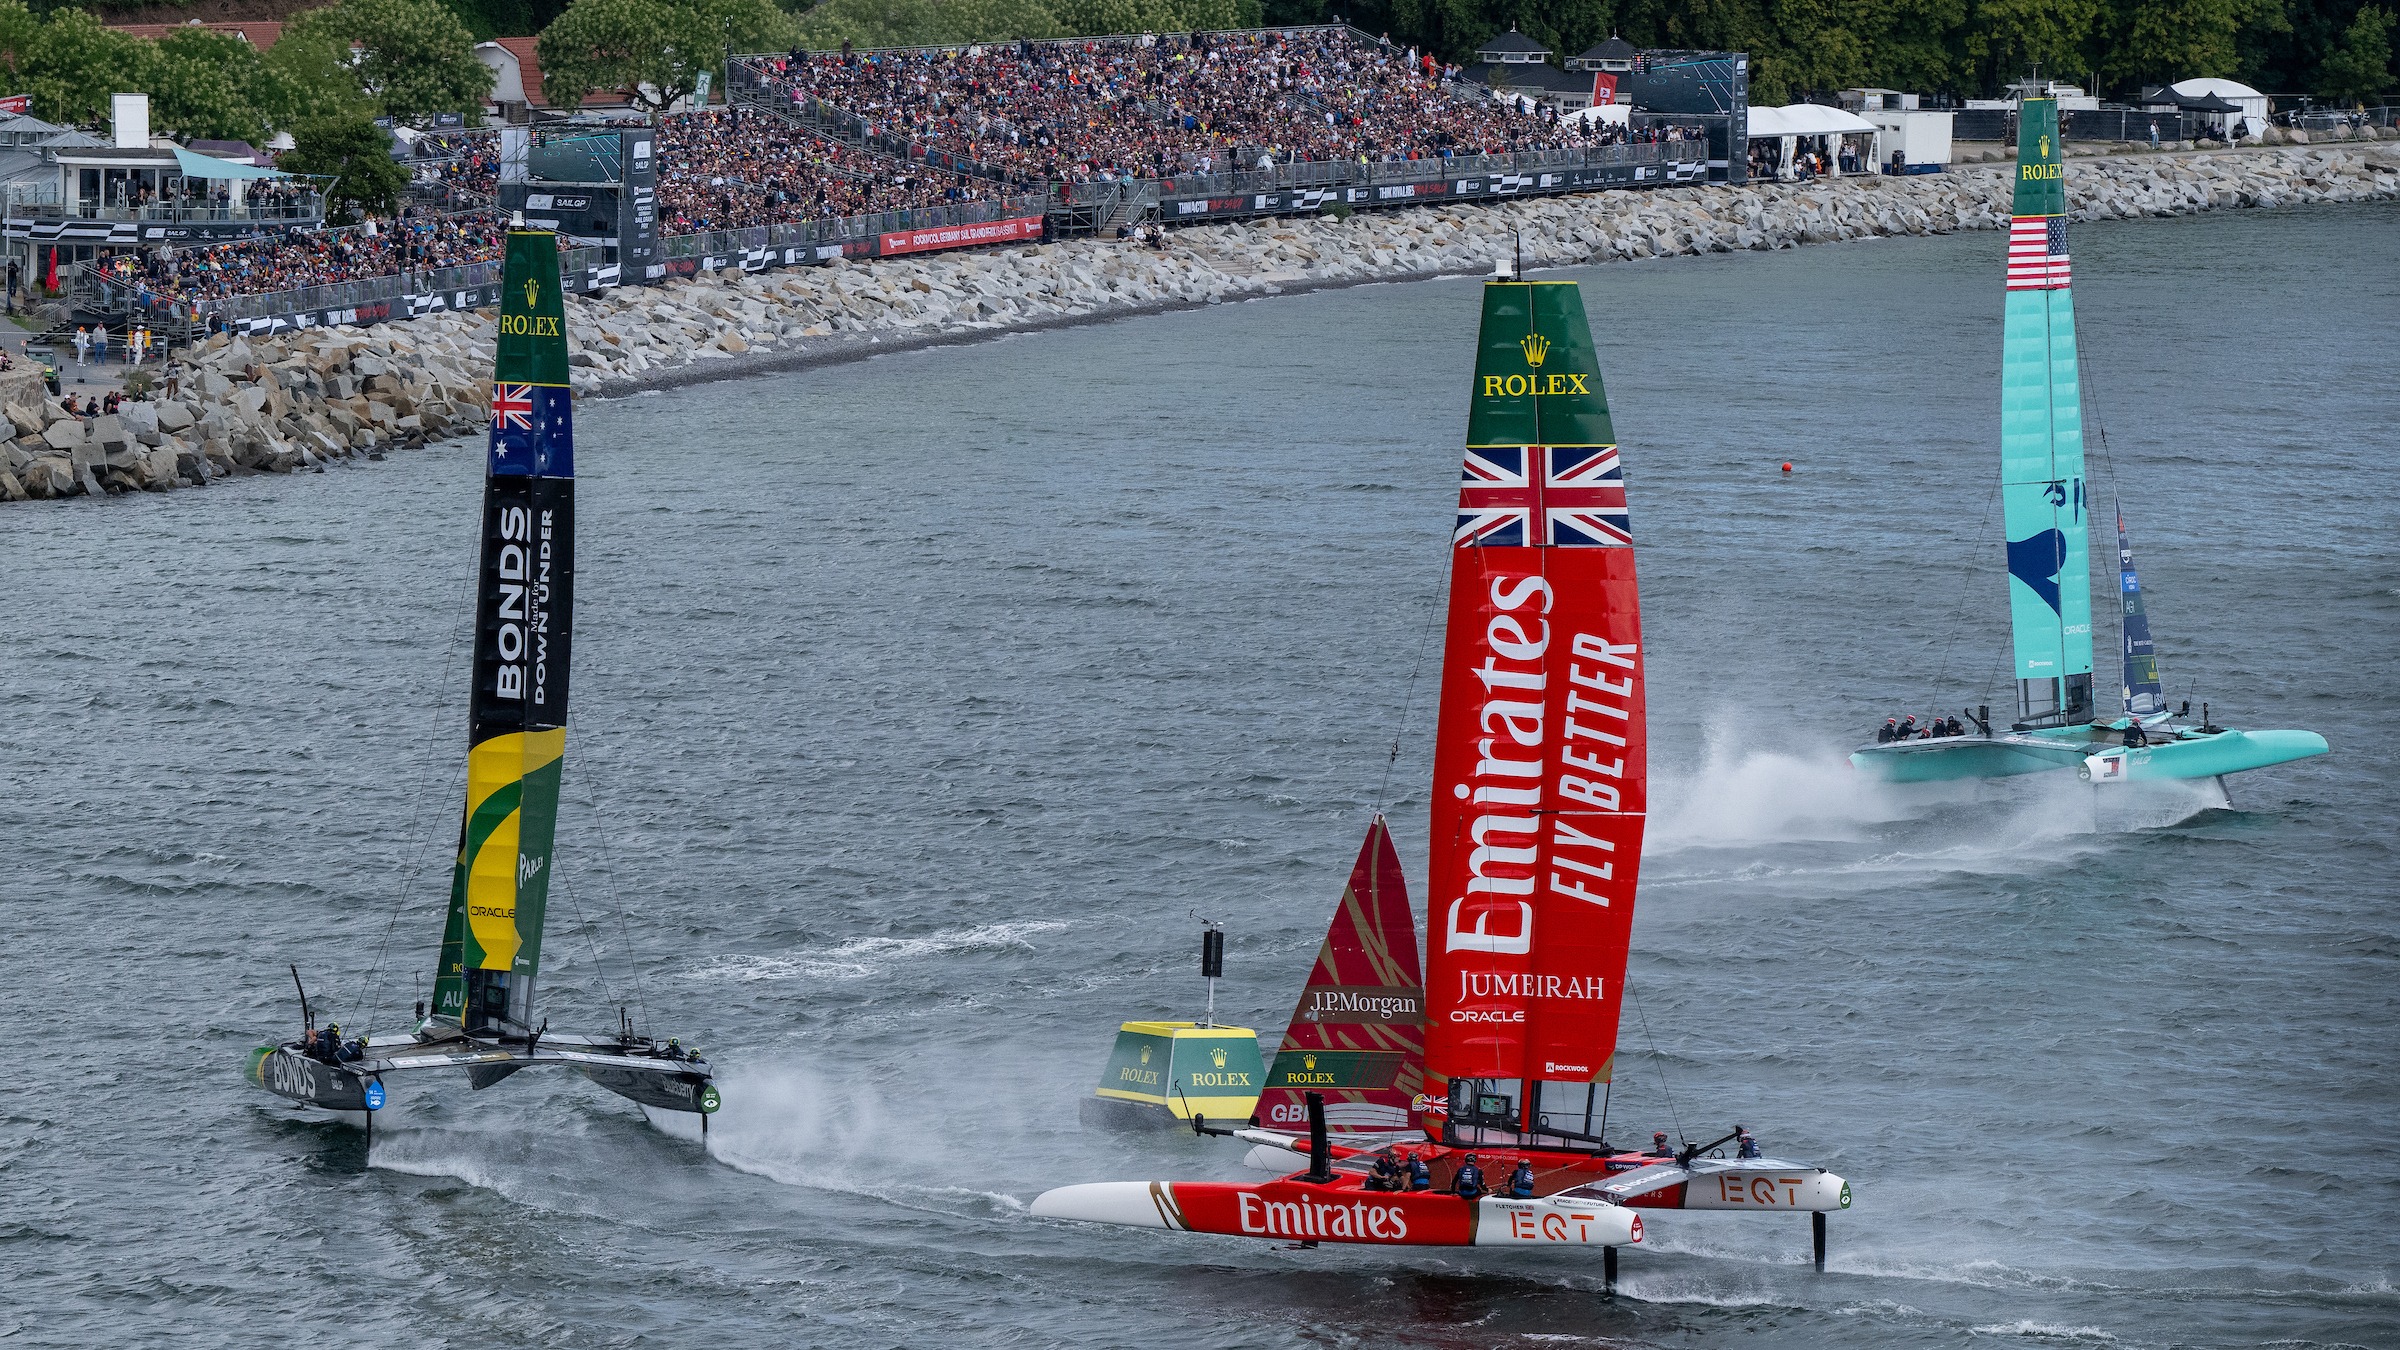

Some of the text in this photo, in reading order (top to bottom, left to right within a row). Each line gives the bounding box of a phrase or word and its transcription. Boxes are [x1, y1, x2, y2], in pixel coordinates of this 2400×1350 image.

[2022, 163, 2063, 180] ROLEX
[501, 314, 559, 336] ROLEX
[1482, 374, 1590, 397] ROLEX
[496, 506, 526, 700] BONDS
[530, 578, 540, 632] Made for
[534, 508, 553, 705] DOWN UNDER
[2064, 624, 2091, 635] ORACLE
[1445, 575, 1555, 955] Emirates
[1549, 632, 1638, 908] FLY BETTER
[470, 905, 515, 919] ORACLE
[1457, 970, 1605, 1004] JUMEIRAH
[1450, 1010, 1525, 1023] ORACLE
[273, 1050, 316, 1099] BONDS
[1119, 1067, 1160, 1085] ROLEX
[1191, 1072, 1251, 1087] ROLEX
[1287, 1072, 1335, 1084] ROLEX
[1555, 1065, 1589, 1073] ROCKWOOL
[1718, 1175, 1803, 1206] EQT
[1237, 1192, 1408, 1239] Emirates
[1510, 1211, 1595, 1242] EQT
